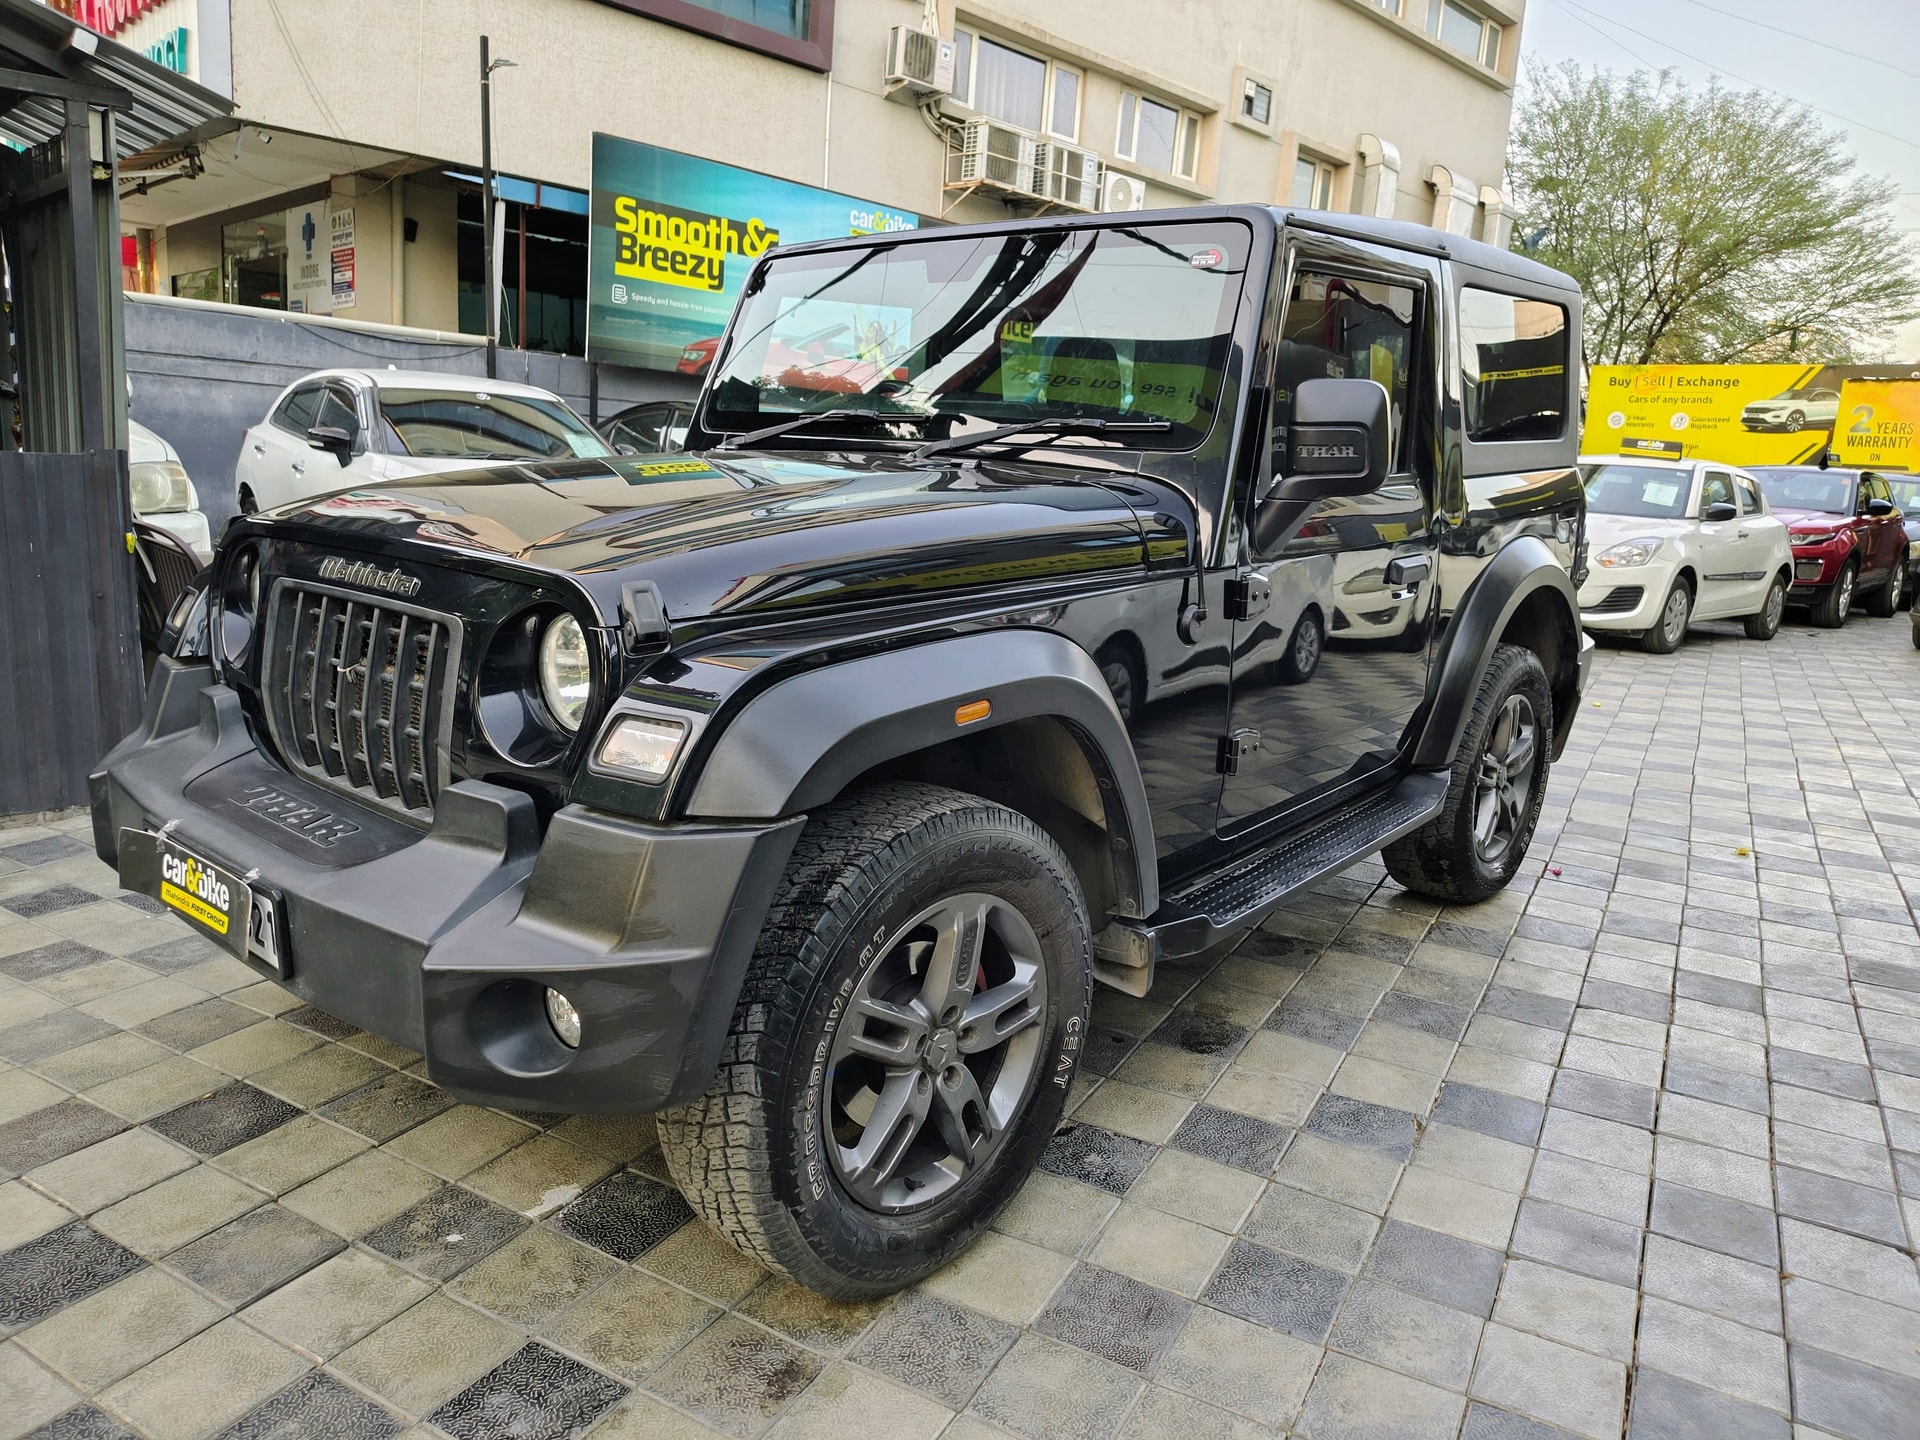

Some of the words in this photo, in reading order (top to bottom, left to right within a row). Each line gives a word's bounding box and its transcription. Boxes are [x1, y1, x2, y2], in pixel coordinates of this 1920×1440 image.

[614, 196, 738, 256] Smooth
[742, 217, 779, 259] &
[615, 232, 725, 291] Breezy
[631, 292, 656, 305] Speedy
[656, 297, 669, 306] and
[669, 299, 704, 312] hassle-free
[1608, 376, 1632, 389] Buy
[1642, 376, 1666, 388] Sell
[1677, 376, 1740, 389] Exchange
[1628, 395, 1649, 404] Cars
[1650, 395, 1661, 404] of
[1662, 397, 1678, 405] any
[1681, 395, 1713, 404] brands
[1691, 416, 1731, 424] Guaranteed
[1849, 403, 1875, 433] 2
[1876, 421, 1915, 435] YEARS
[1296, 445, 1359, 458] THAR
[1846, 435, 1912, 449] WARRANTY
[1869, 453, 1881, 462] ON
[318, 555, 422, 597] Mahindra
[228, 784, 361, 848] THAR
[162, 853, 230, 911] car&bike
[190, 902, 207, 917] FIRST
[206, 911, 226, 928] CHOICE
[249, 901, 278, 956] 21
[1053, 1016, 1081, 1089] CEAT
